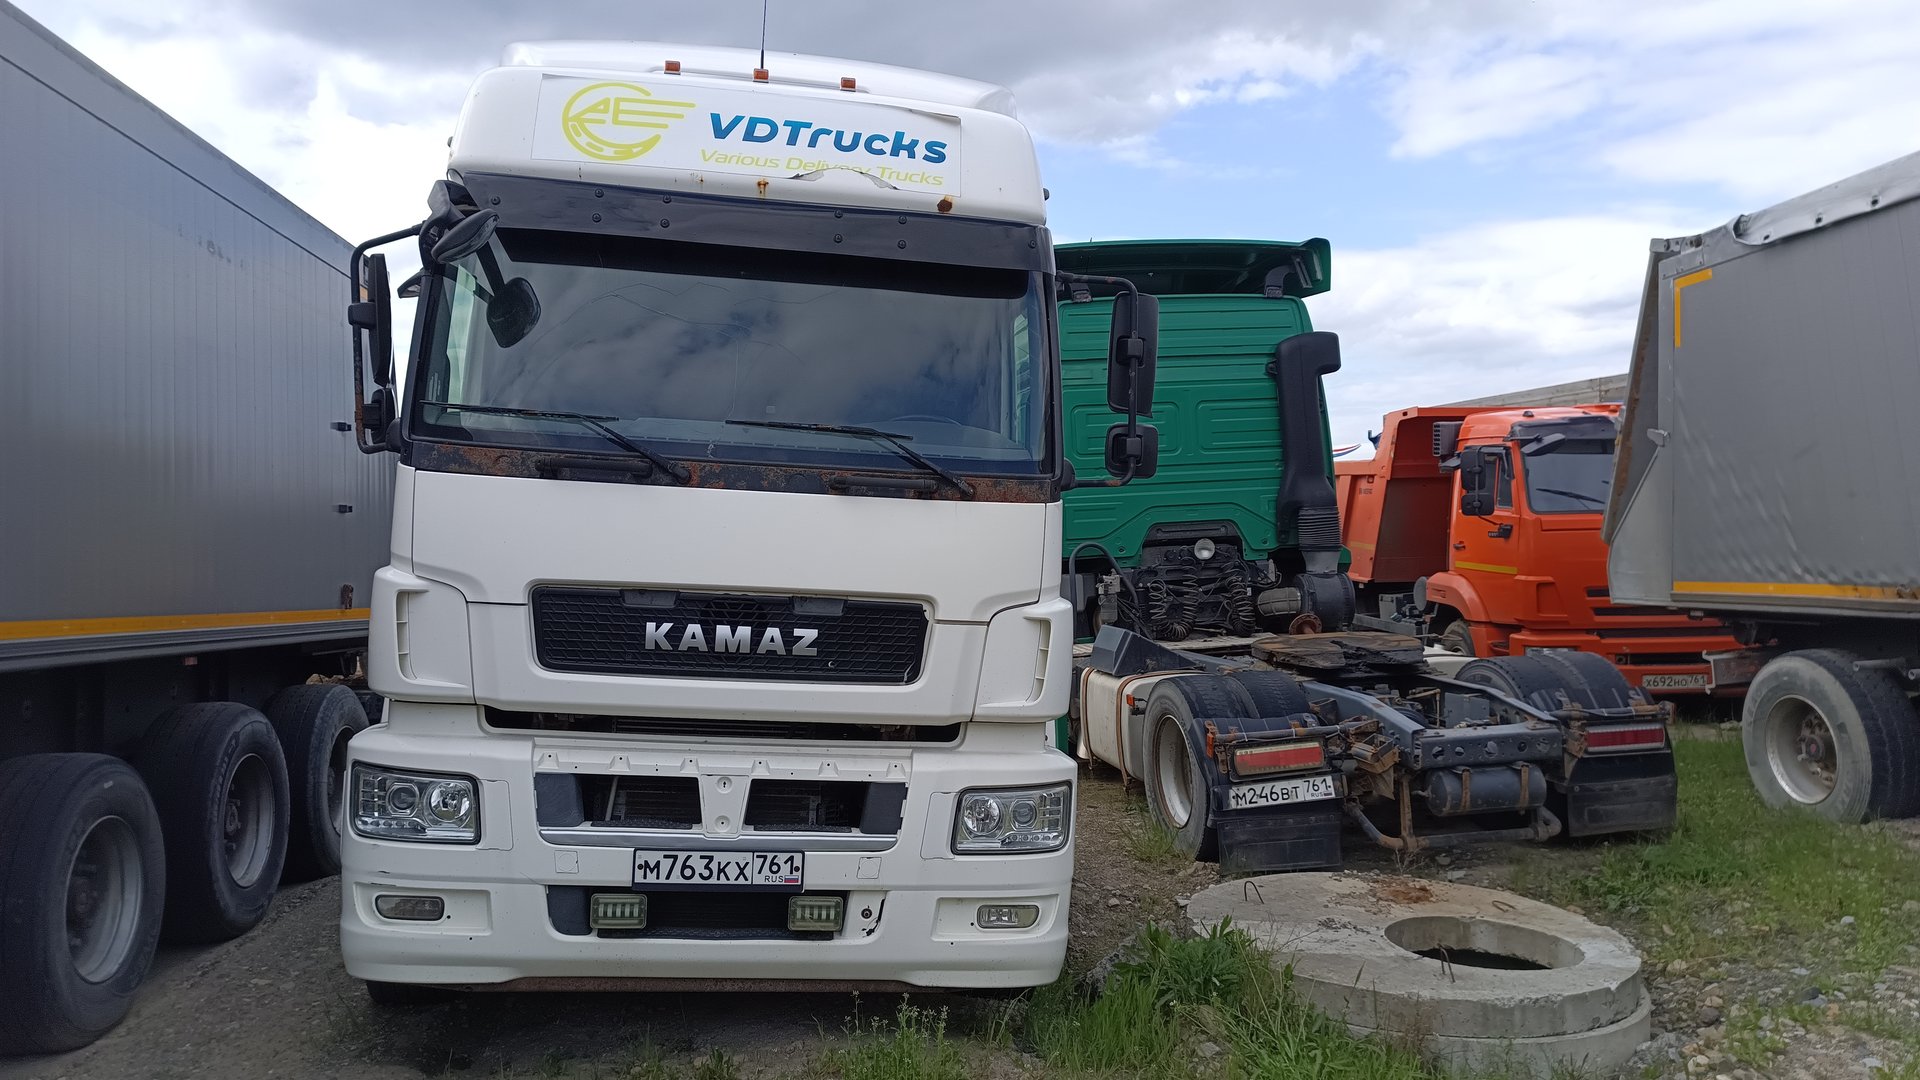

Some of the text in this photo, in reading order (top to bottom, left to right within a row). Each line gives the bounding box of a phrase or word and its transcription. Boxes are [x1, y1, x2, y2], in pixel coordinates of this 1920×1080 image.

[709, 112, 948, 164] VDTrucks
[700, 149, 944, 186] Various Deli Trucks
[644, 621, 819, 657] KAMAZ
[1303, 778, 1329, 793] 761
[755, 854, 795, 875] 761
[764, 875, 784, 883] RUS
